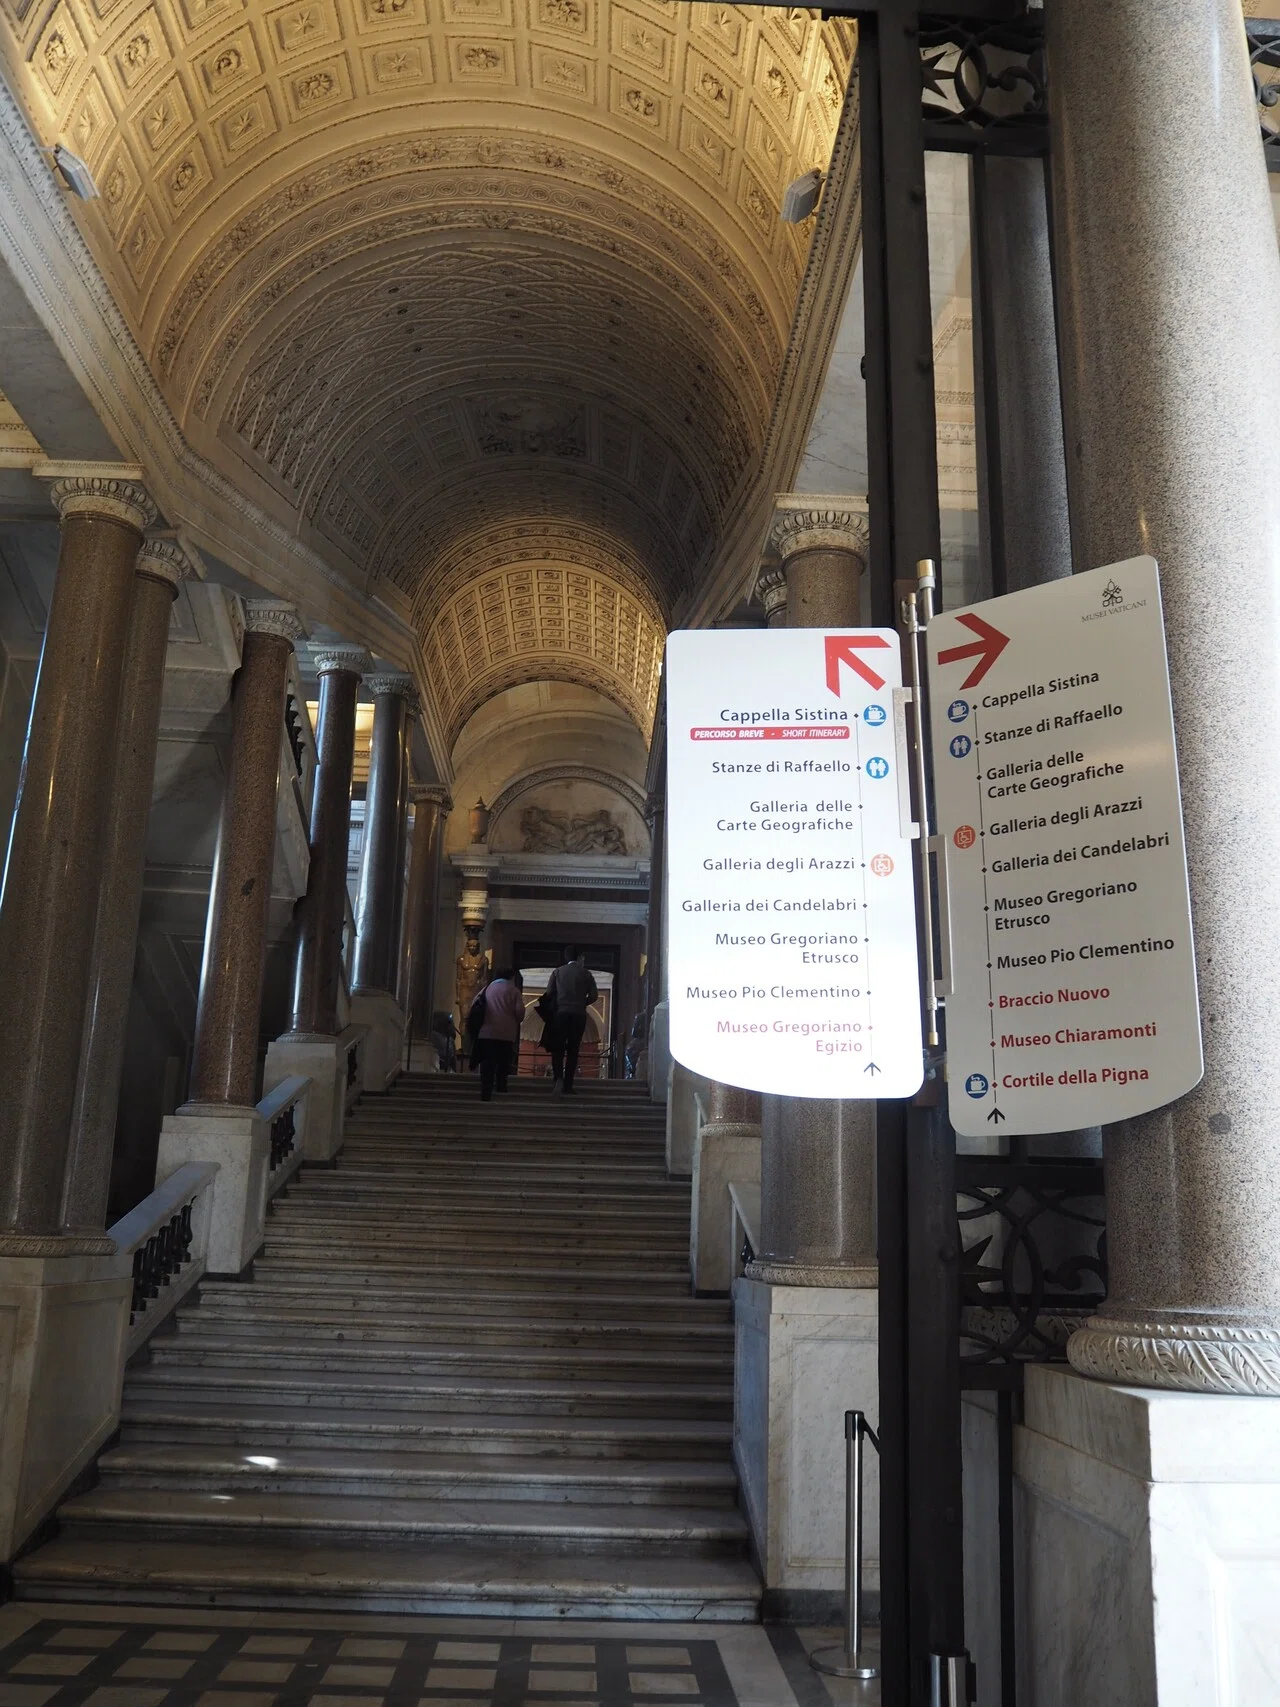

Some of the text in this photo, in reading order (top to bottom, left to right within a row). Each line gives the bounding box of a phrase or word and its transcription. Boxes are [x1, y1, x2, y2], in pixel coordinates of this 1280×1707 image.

[1081, 600, 1147, 622] MUSEI VATICANI
[982, 672, 1099, 708] Cappella Sistina
[720, 709, 848, 724] Cappella Sistina
[984, 704, 1123, 745] Stanze di Raffaello
[695, 730, 736, 738] PERCORSO
[782, 729, 806, 737] SHORT
[712, 761, 850, 773] Stanze di Raffaello
[986, 750, 1084, 780] Galleria delle
[987, 762, 1124, 798] Carte Geografiche
[750, 801, 852, 812] Galleria delle
[990, 797, 1143, 836] Galleria degli Arazzi
[717, 819, 853, 833] Carte Geografiche
[992, 832, 1170, 873] Galleria dei Candelabri
[703, 858, 854, 872] Galleria degli Arazzi
[994, 881, 1137, 911] Museo Gregoriano
[682, 899, 857, 912] Galleria dei Candelabri
[995, 914, 1050, 930] Etrusco
[715, 932, 858, 948] Museo Gregoriano
[802, 952, 859, 963] Etrusco
[997, 937, 1175, 969] Museo Pio Clementino
[687, 986, 860, 998] Museo Pio Clementino
[999, 988, 1110, 1009] Braccio Nuovo
[717, 1020, 861, 1036] Museo Gregoriano
[1001, 1023, 1157, 1048] Museo Chiaramonti
[816, 1040, 862, 1055] Egizio
[1002, 1068, 1149, 1088] Cortile della Pigna
